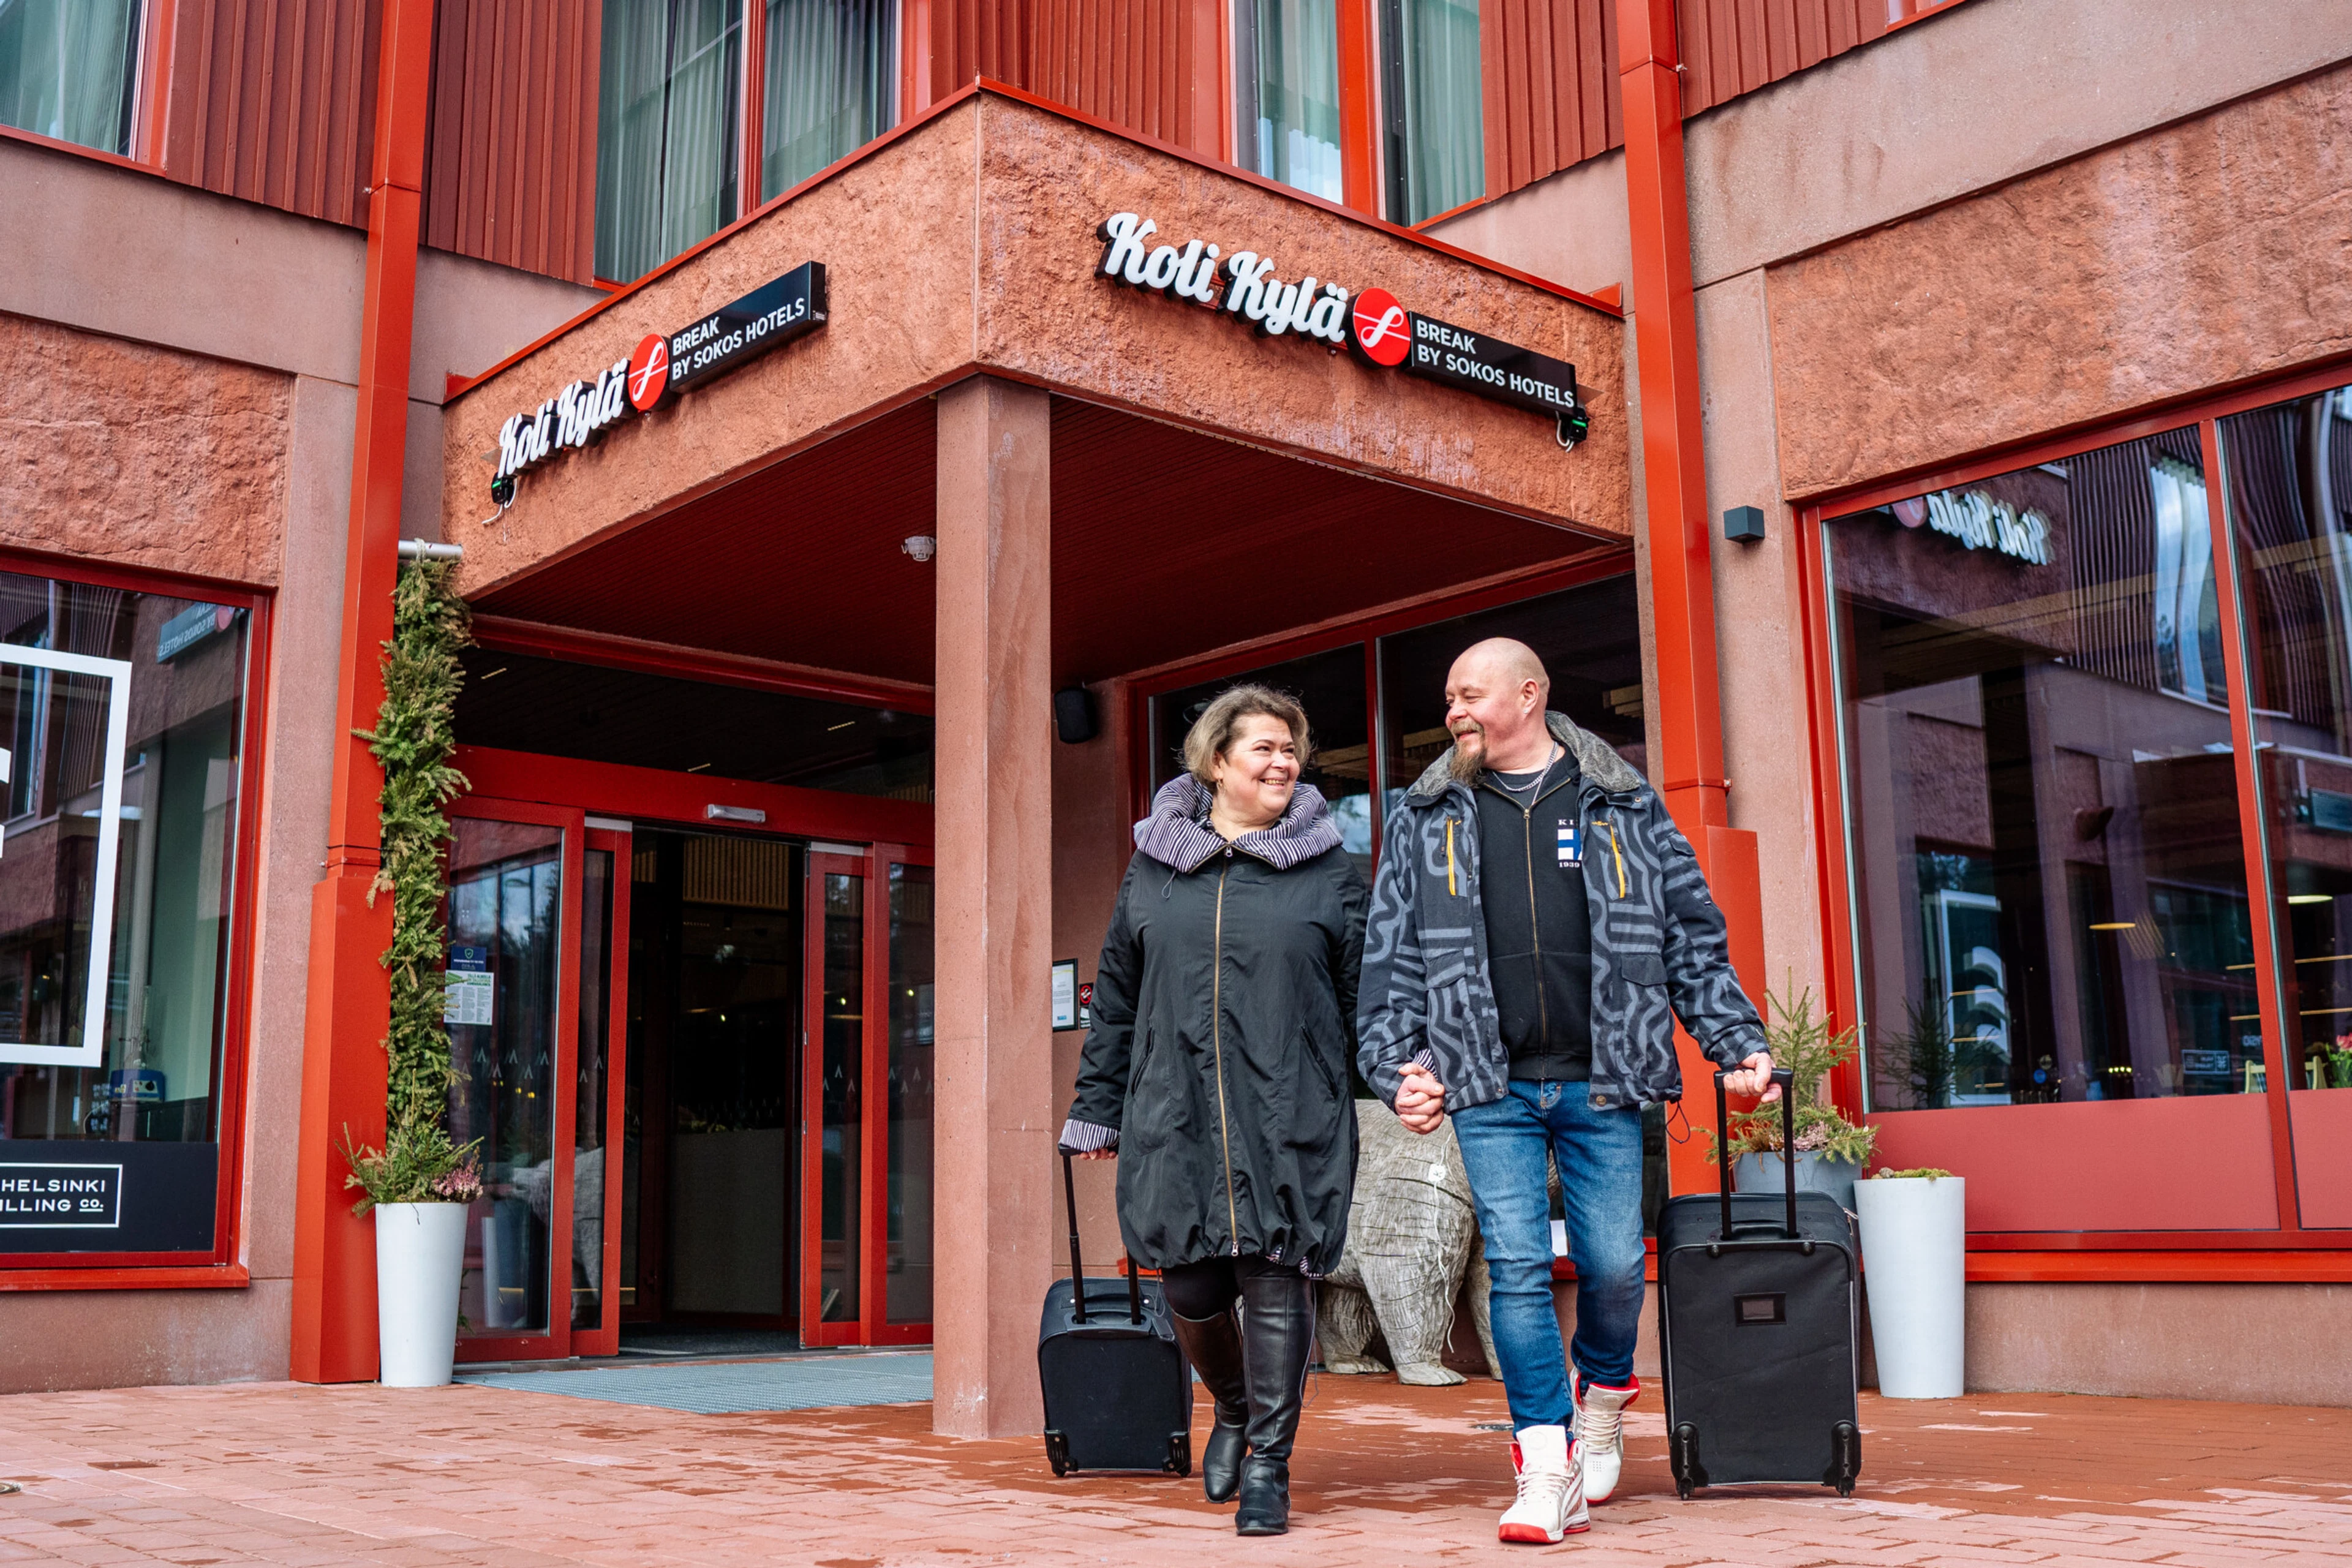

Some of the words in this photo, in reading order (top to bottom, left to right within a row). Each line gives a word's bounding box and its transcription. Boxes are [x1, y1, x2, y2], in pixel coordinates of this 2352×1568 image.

[1105, 211, 1220, 303] Koli
[1227, 251, 1349, 343] Kylä
[673, 317, 719, 356] BREAK
[673, 356, 691, 380] BY
[694, 330, 742, 368] SOKOS
[746, 298, 804, 342] HOTELS
[1417, 320, 1476, 354] BREAK
[1418, 344, 1441, 366] BY
[1446, 353, 1505, 386] SOKOS
[1510, 374, 1574, 408] HOTELS
[497, 398, 554, 478] Koli
[556, 356, 628, 448] Kylä
[2, 1179, 105, 1192] HELSINKI
